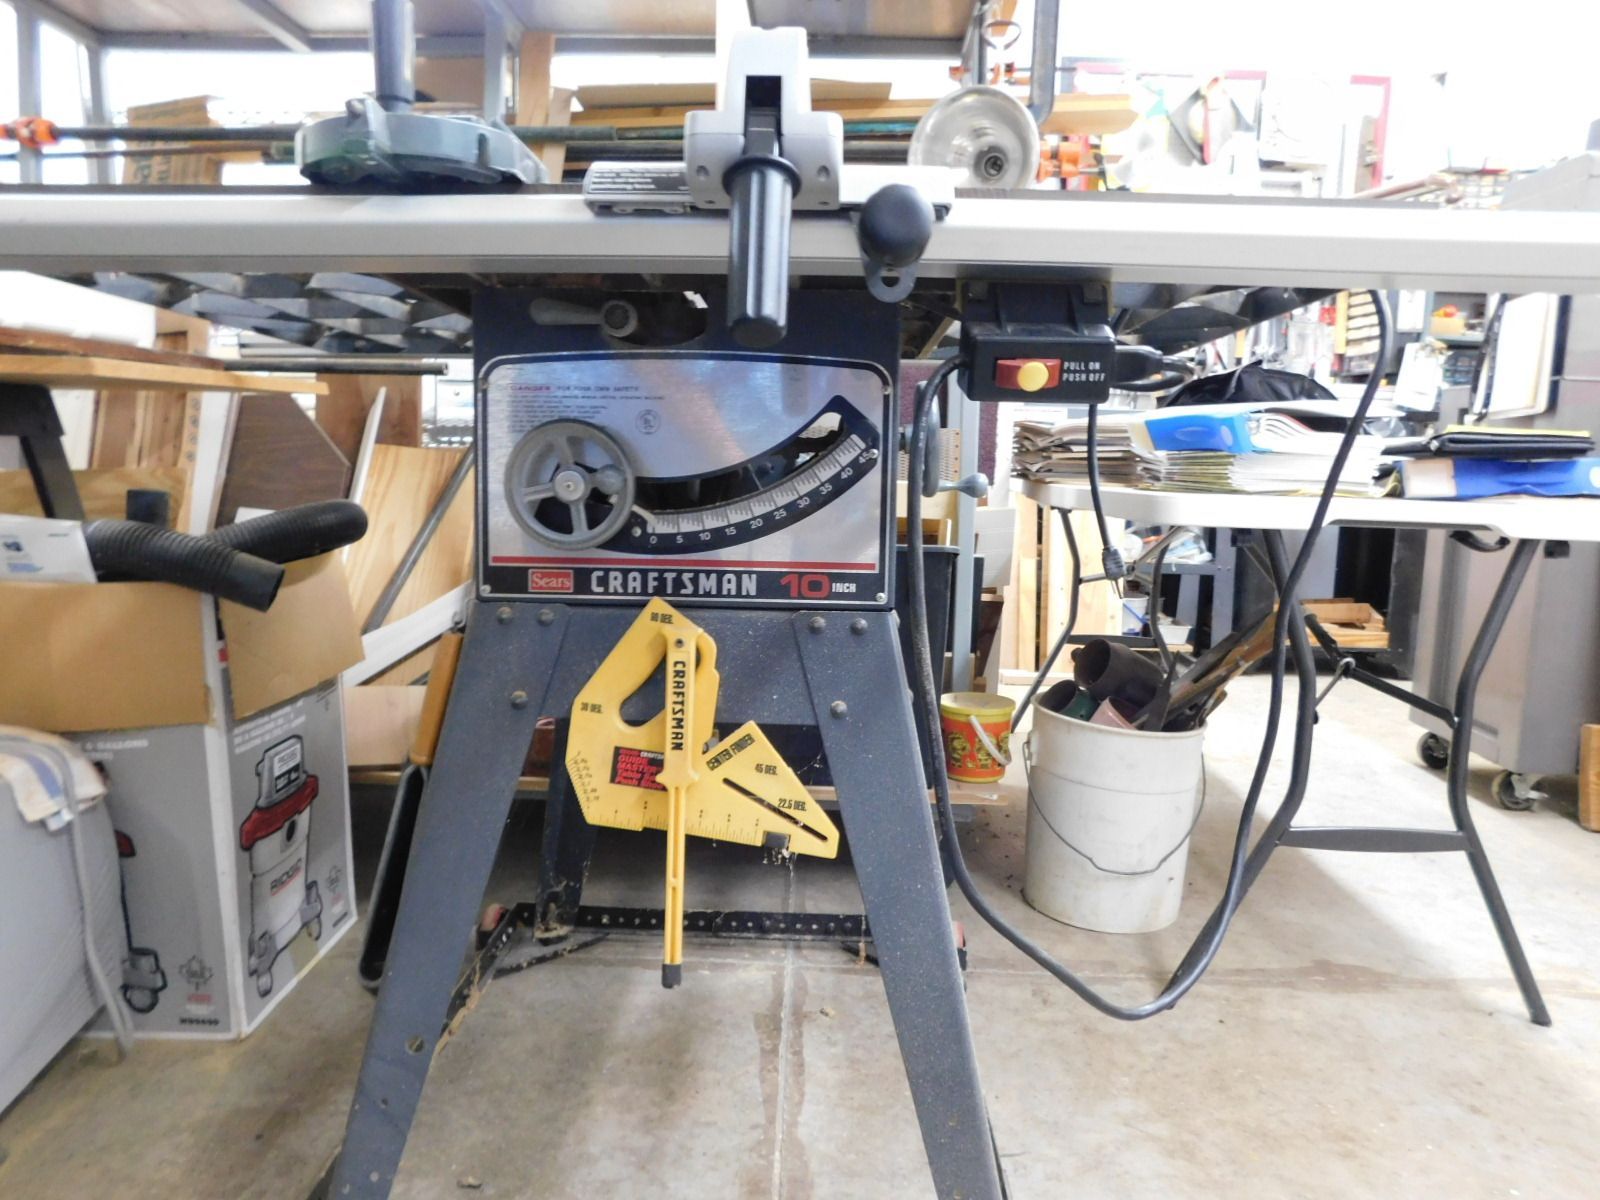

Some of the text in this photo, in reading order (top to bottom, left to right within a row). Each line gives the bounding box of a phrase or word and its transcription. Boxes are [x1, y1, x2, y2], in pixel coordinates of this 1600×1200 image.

[1064, 361, 1101, 370] PULL ON
[1063, 373, 1106, 382] PUSH OFF
[841, 467, 853, 479] 40
[820, 484, 833, 495] 35
[797, 497, 810, 508] 30
[774, 509, 787, 520] 25
[750, 519, 763, 528] 20
[700, 532, 711, 541] 10
[726, 527, 736, 536] 15
[650, 536, 657, 544] 0
[676, 535, 684, 544] 5
[532, 573, 570, 590] Sears
[591, 571, 757, 596] CRAFTSMAN
[780, 573, 857, 598] 10 INCH
[670, 660, 686, 751] CRAFTSMAN
[754, 763, 778, 776] 45 DEG.
[777, 798, 807, 812] 22.5 DEG.
